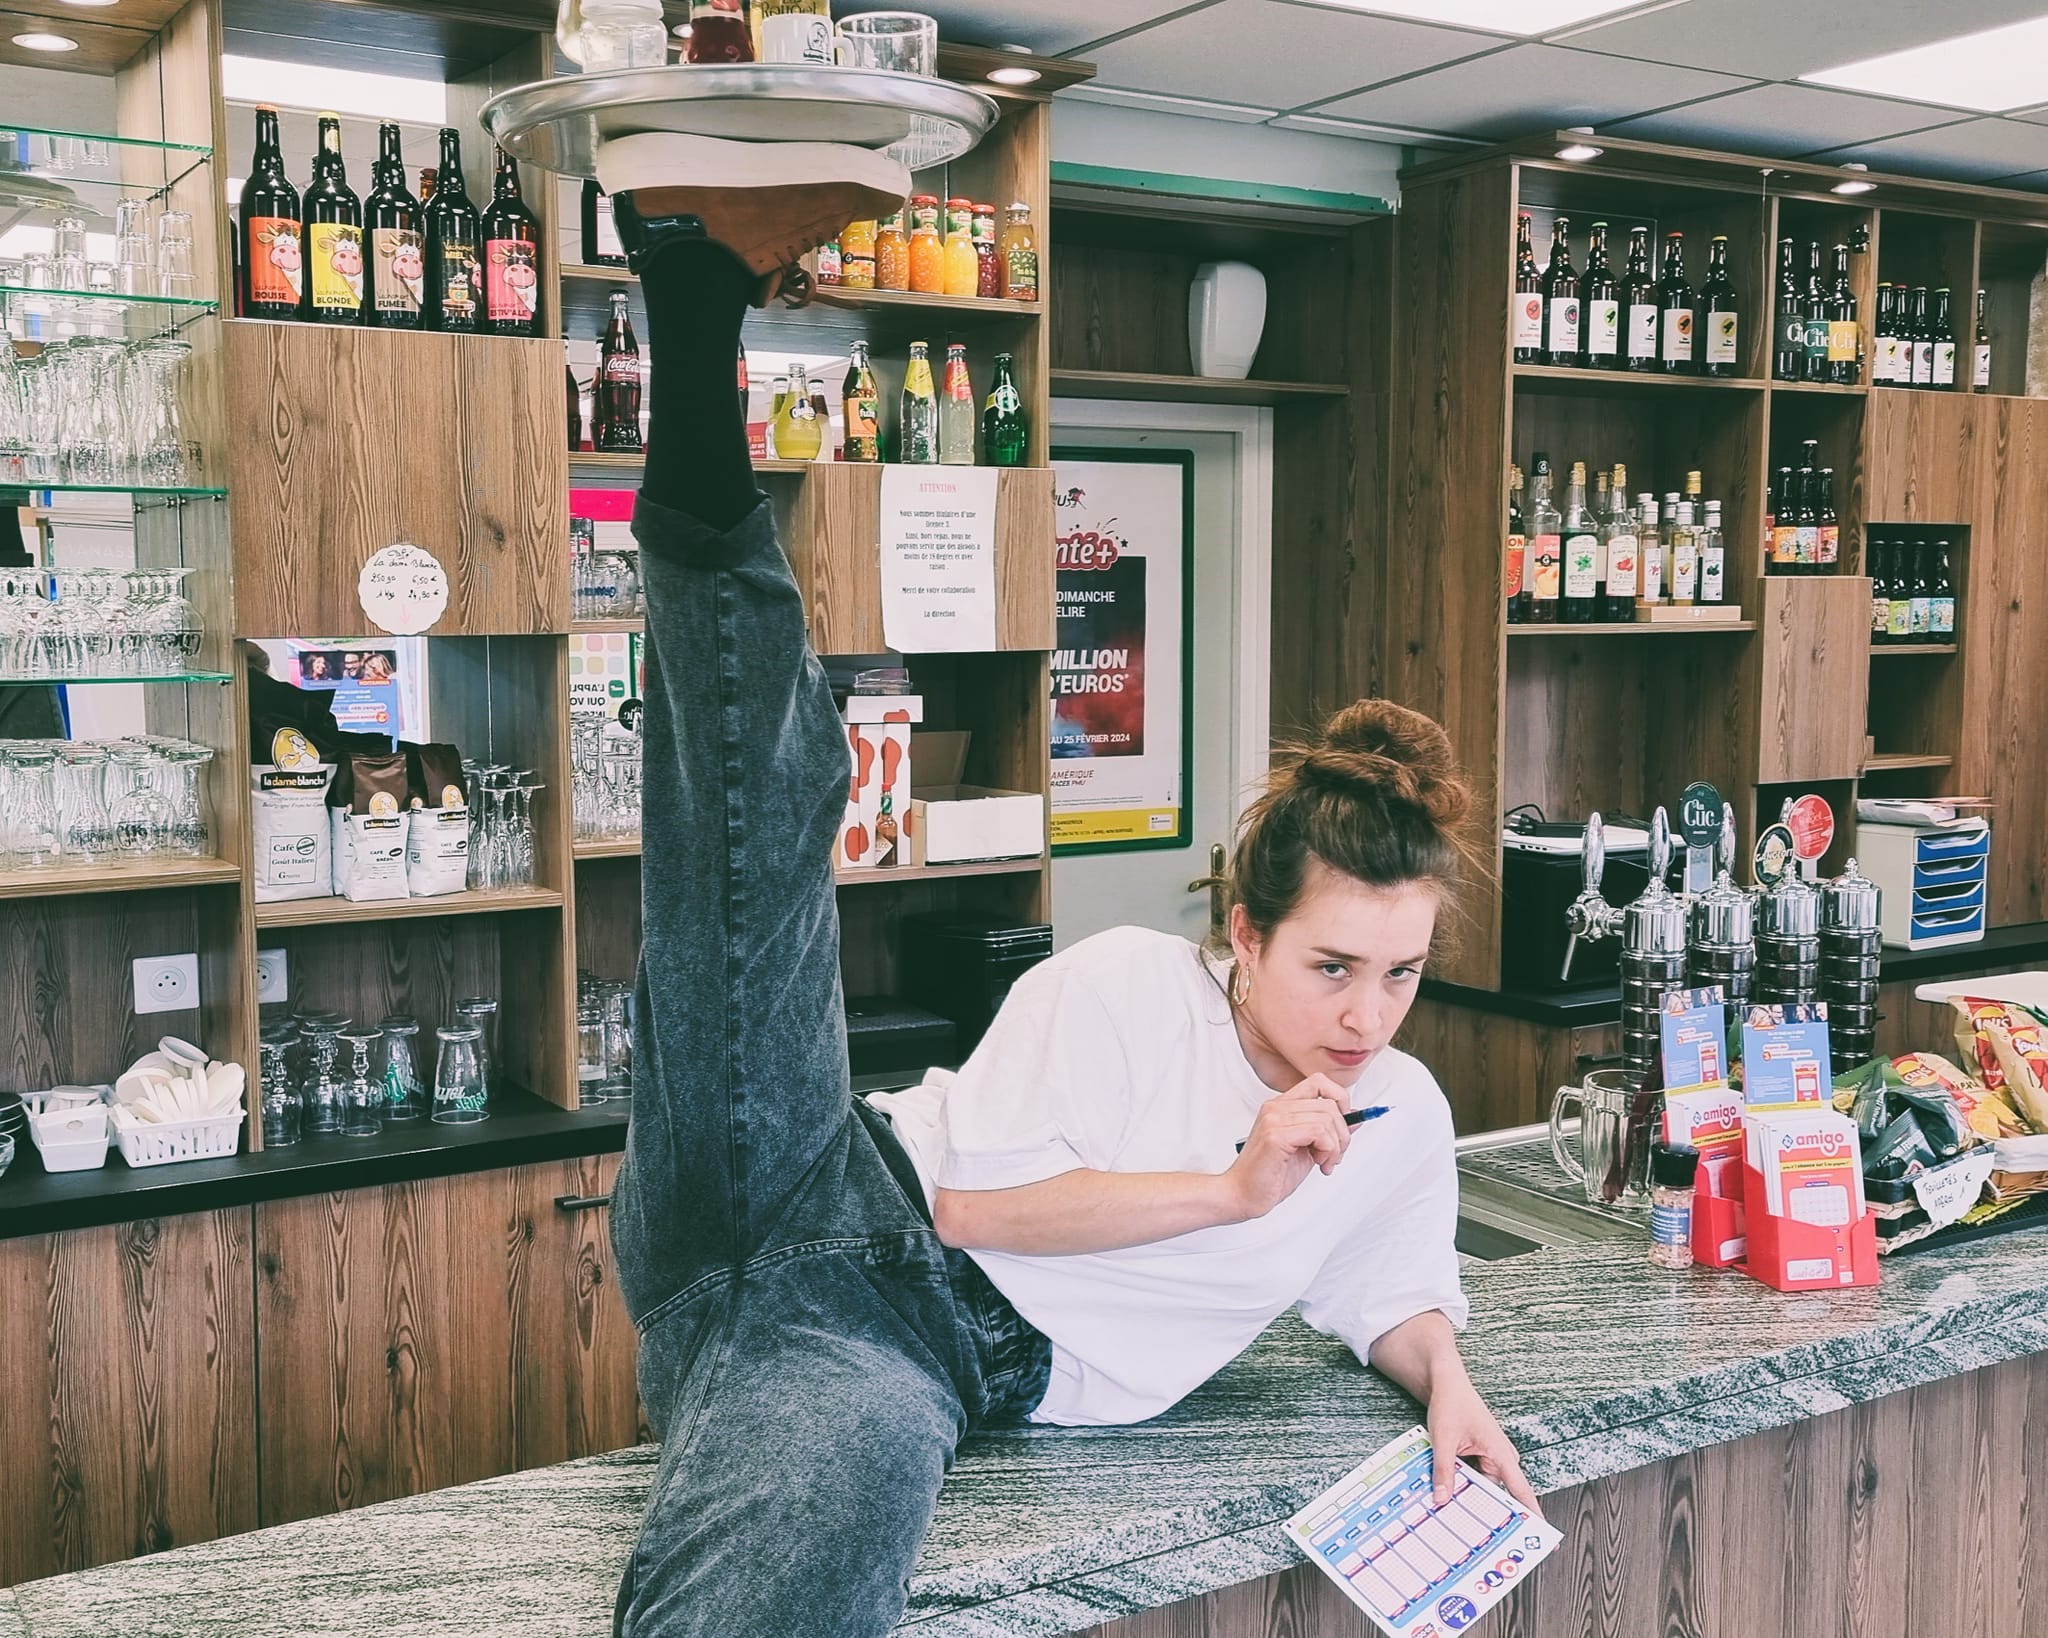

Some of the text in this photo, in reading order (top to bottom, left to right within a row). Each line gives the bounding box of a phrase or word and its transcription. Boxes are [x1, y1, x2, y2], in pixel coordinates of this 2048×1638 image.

[254, 290, 288, 300] ROUSSE
[316, 296, 352, 305] BLONDE
[378, 300, 407, 308] FUMÉE
[1057, 591, 1116, 602] DIMANCHE
[1064, 736, 1074, 744] 25
[1077, 733, 1109, 744] FÉVRIER
[1110, 733, 1130, 742] 2024
[274, 844, 294, 852] Café
[1703, 1104, 1737, 1126] amigo
[1796, 1130, 1844, 1153] amigo
[1474, 1549, 1524, 1594] LOTO
[1456, 1610, 1470, 1624] 2
